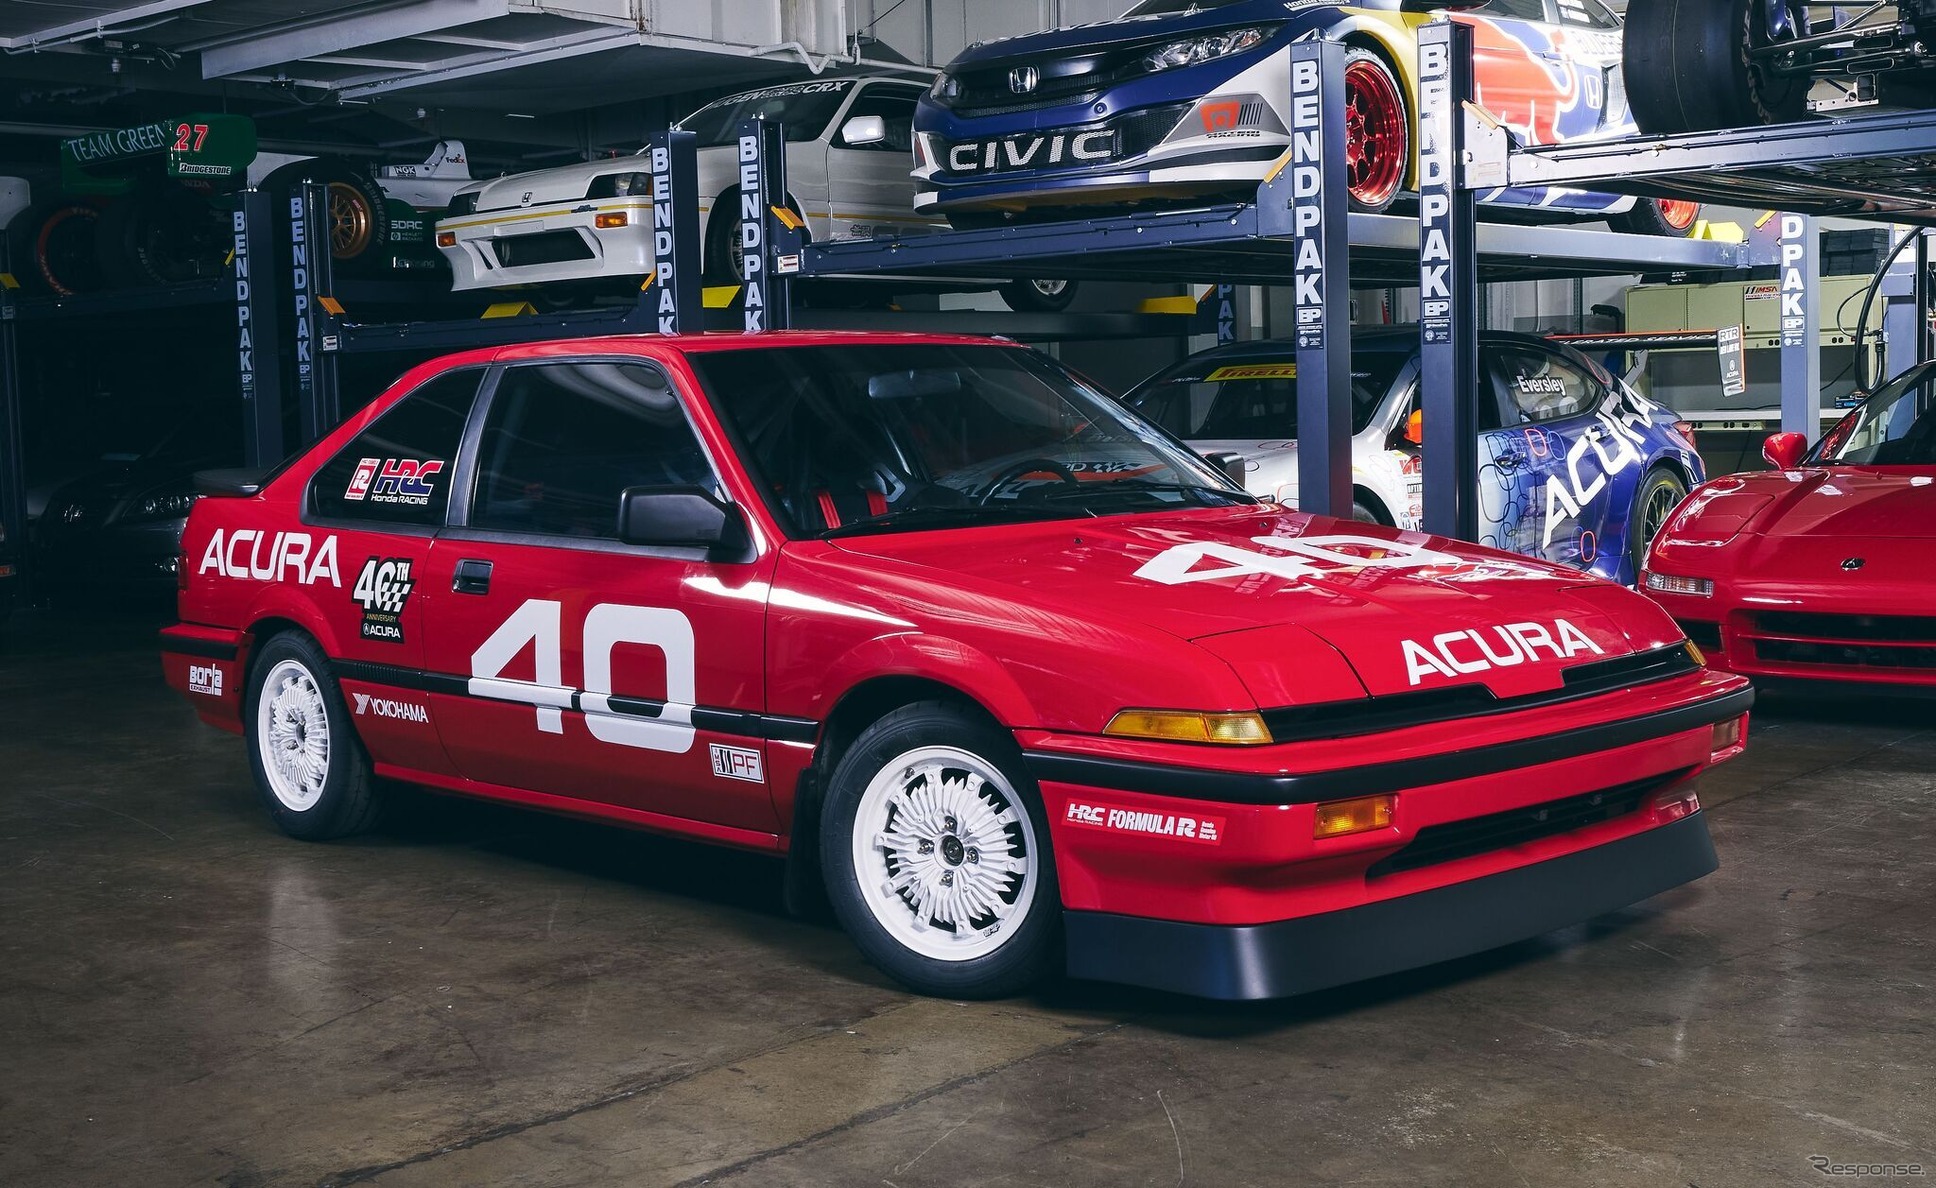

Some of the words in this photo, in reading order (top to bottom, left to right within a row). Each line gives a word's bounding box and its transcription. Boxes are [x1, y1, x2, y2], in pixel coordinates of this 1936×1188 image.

[802, 81, 849, 94] CRX
[68, 132, 118, 162] TEAM
[116, 123, 166, 153] GREEN
[173, 123, 208, 151] 27
[950, 128, 1115, 170] CIVIC
[179, 162, 232, 174] BRIDGESTONE
[395, 166, 415, 175] NGK
[391, 220, 423, 230] SDRC
[1720, 328, 1739, 341] RTR
[1516, 375, 1566, 395] Eversley
[1542, 378, 1659, 550] ACURA
[372, 458, 445, 497] HRC
[371, 494, 398, 503] Honda
[398, 496, 429, 505] RACING
[199, 528, 342, 588] ACURA
[1132, 535, 1462, 585] 40
[366, 613, 397, 622] ANNIVERSARY
[370, 624, 401, 638] ACURA
[1400, 618, 1604, 686] ACURA
[468, 598, 696, 754] 40
[370, 698, 429, 723] YOKOHAMA
[732, 753, 757, 775] PF
[1068, 804, 1105, 821] HRC
[1108, 809, 1174, 835] FORMULA
